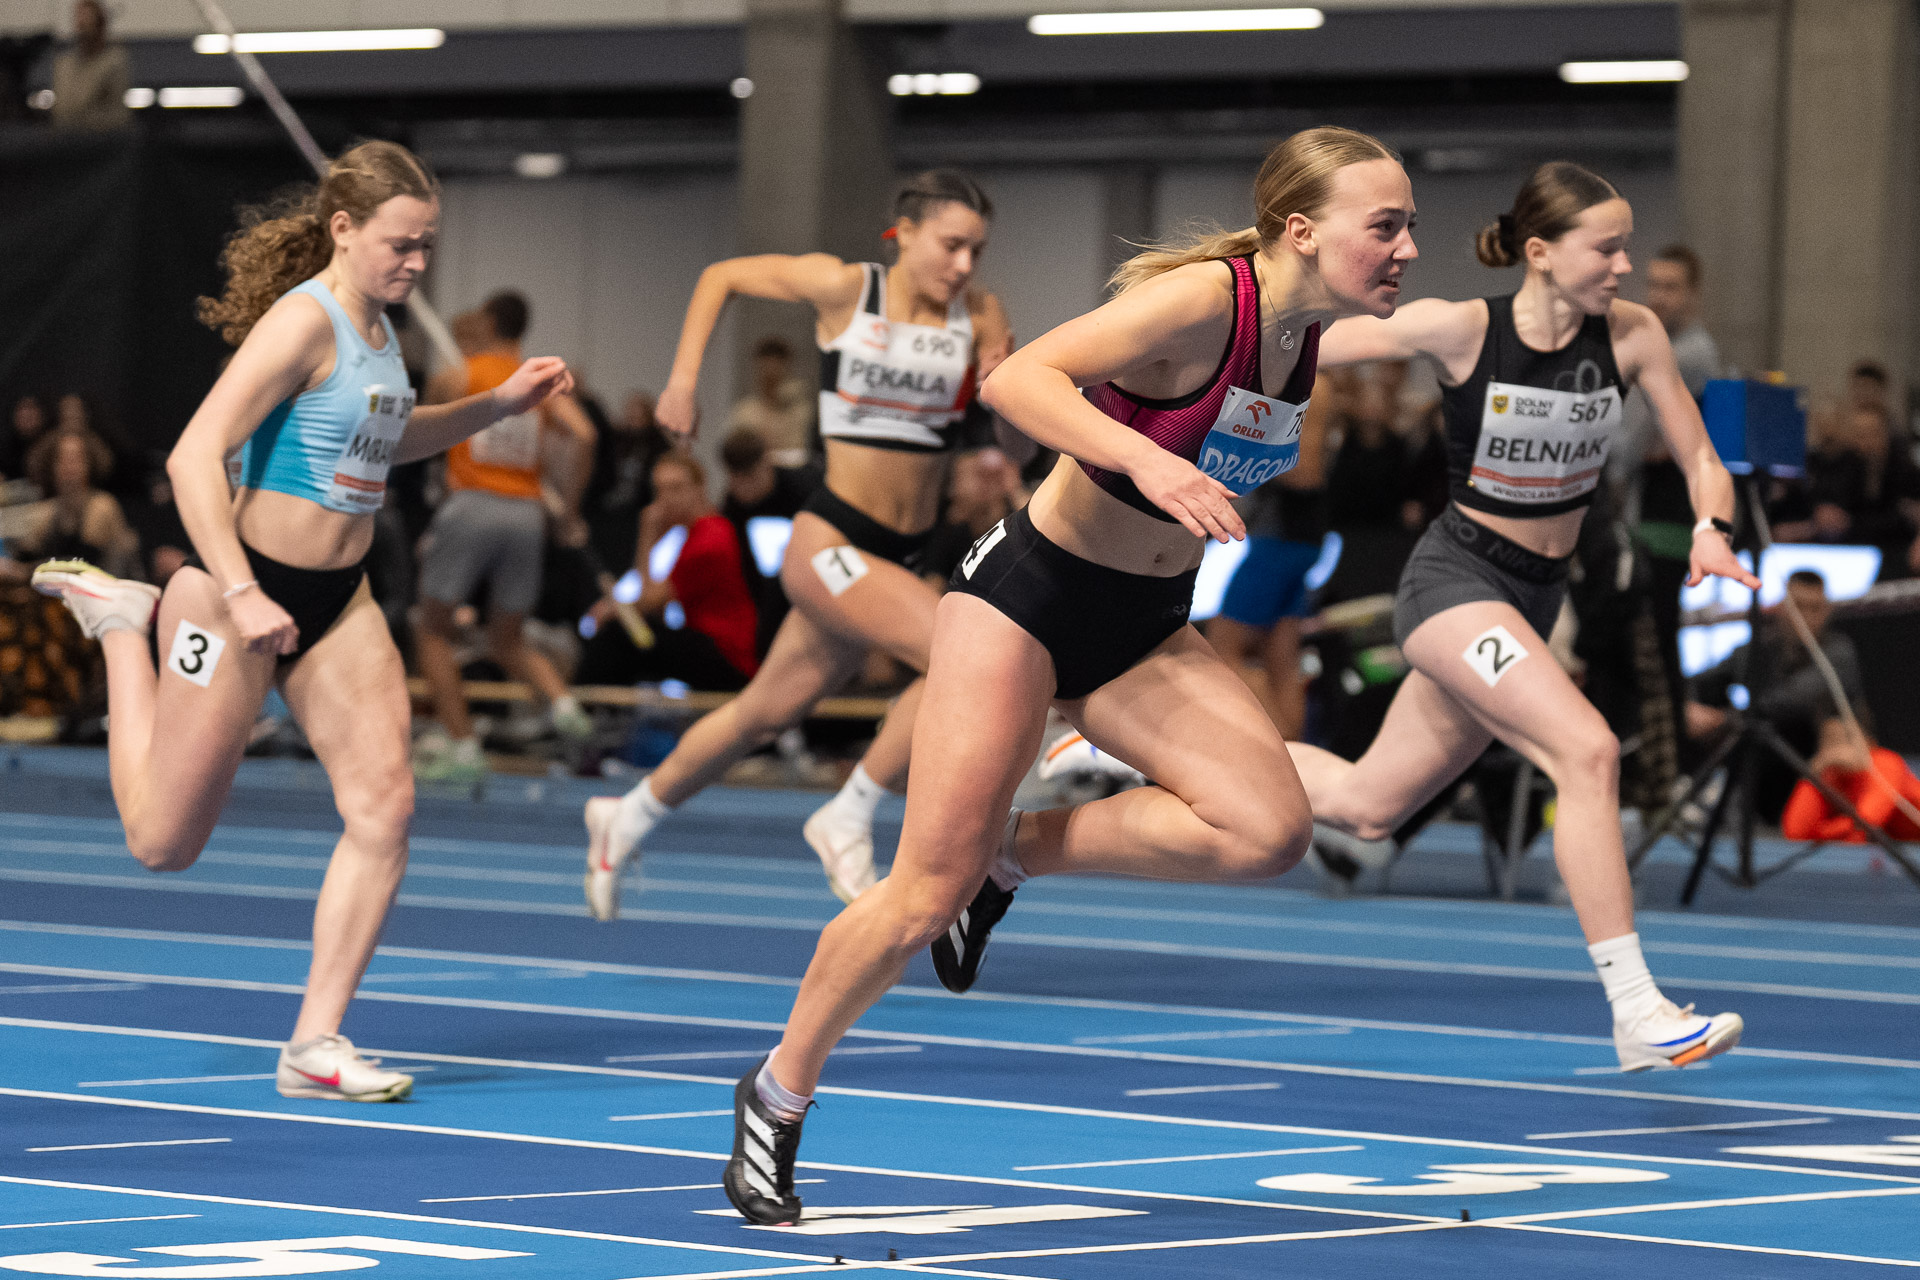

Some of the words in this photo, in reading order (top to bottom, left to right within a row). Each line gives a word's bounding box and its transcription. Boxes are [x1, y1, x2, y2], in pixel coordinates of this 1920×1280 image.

[1568, 397, 1613, 422] 567
[1232, 424, 1266, 440] ORLEN
[1486, 435, 1609, 464] BELNIAK
[829, 551, 852, 578] 1
[178, 633, 209, 675] 3
[1477, 637, 1516, 674] 2
[1255, 1163, 1671, 1196] 3
[0, 1235, 538, 1279] 5
